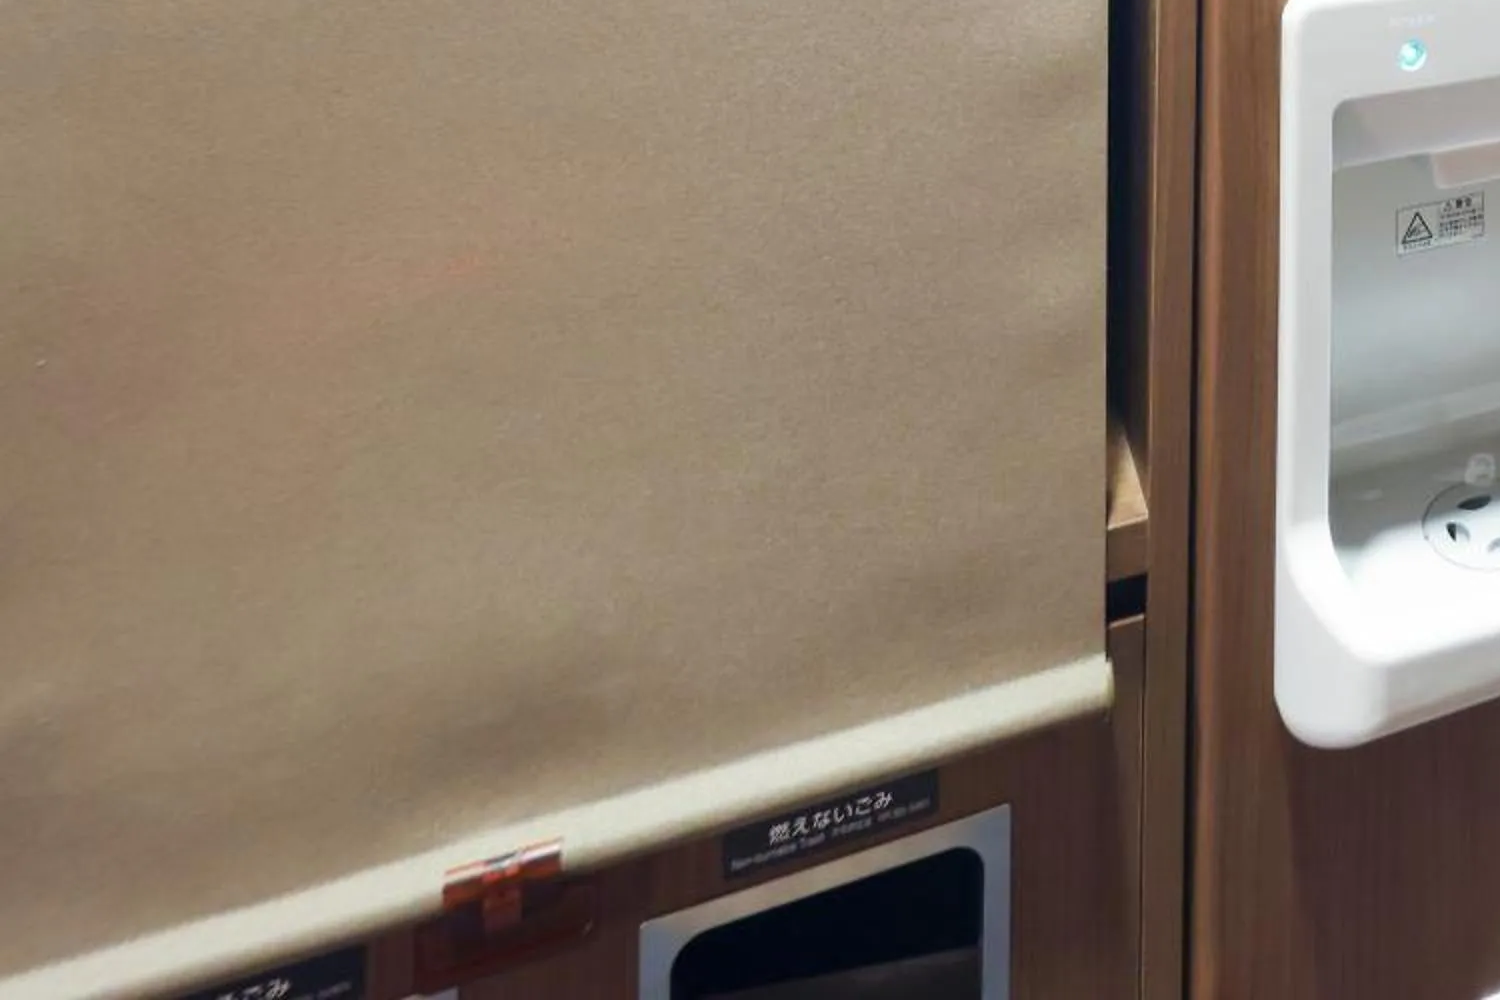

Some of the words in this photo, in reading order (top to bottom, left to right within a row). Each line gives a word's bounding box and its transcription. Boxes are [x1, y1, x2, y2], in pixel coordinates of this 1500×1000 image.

[768, 791, 894, 846] 燃えないごみ
